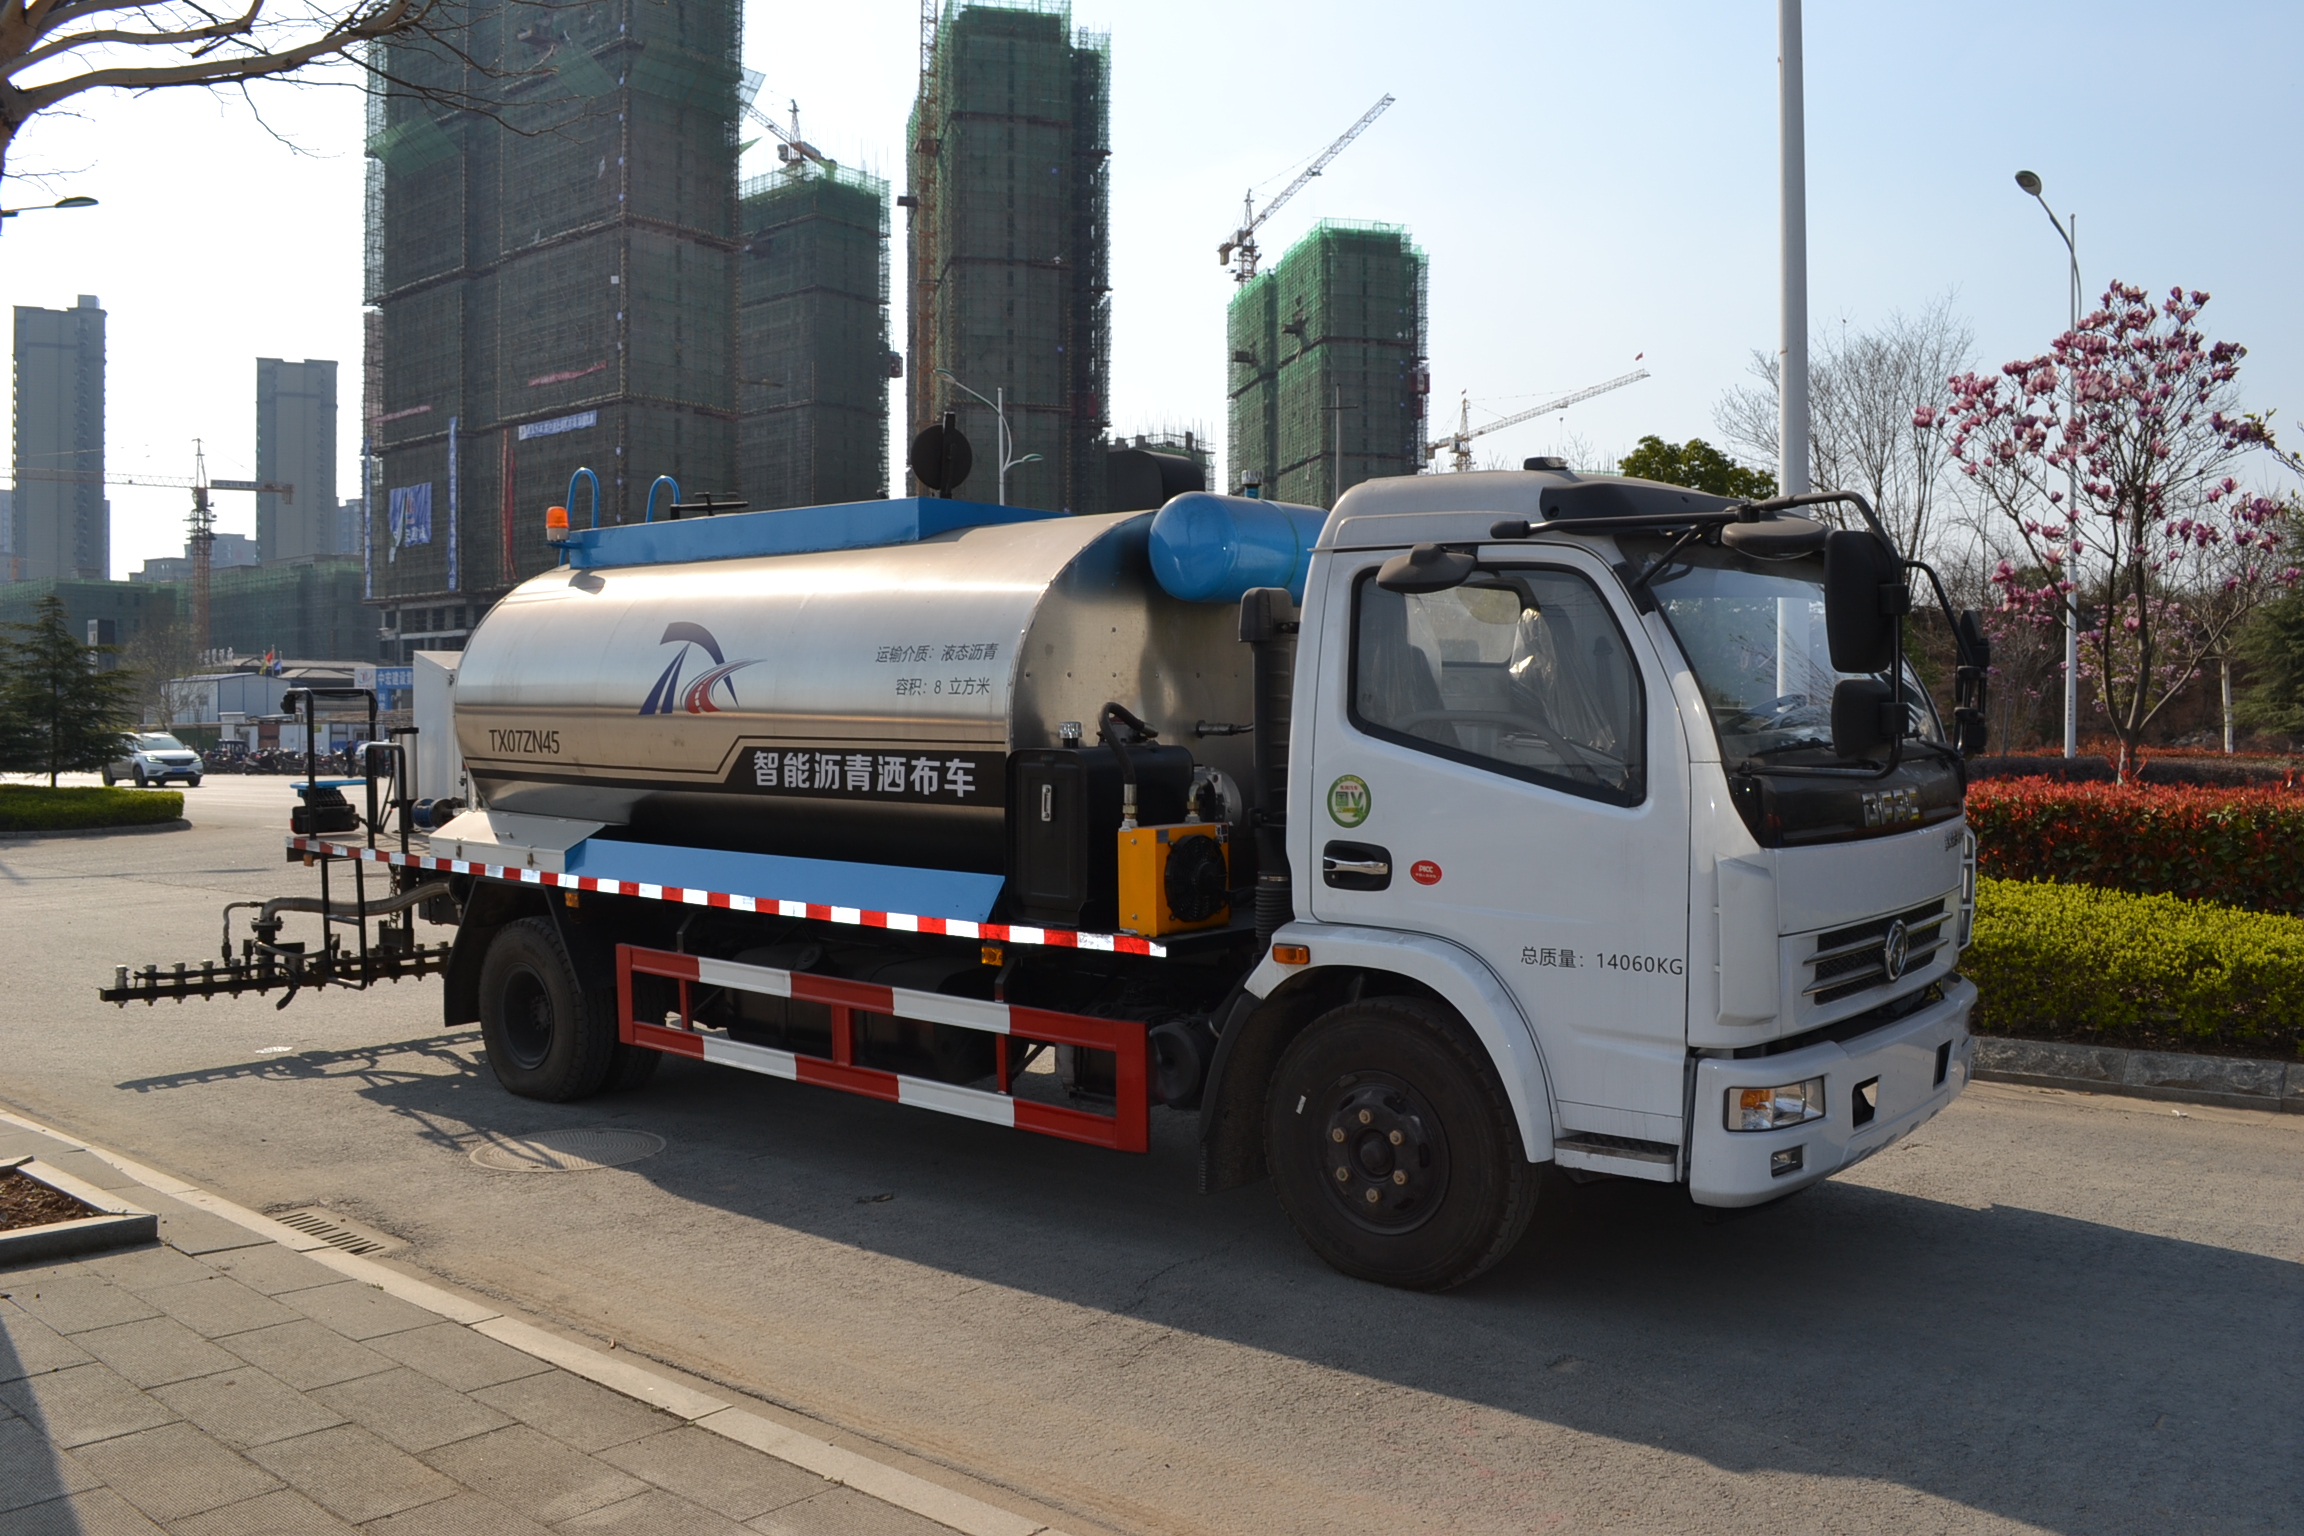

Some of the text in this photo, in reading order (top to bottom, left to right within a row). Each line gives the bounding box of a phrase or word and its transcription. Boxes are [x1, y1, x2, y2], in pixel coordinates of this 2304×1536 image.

[489, 729, 560, 754] TX07ZN45
[753, 751, 976, 797] 智能沥青洒布车
[1418, 865, 1434, 873] PICC
